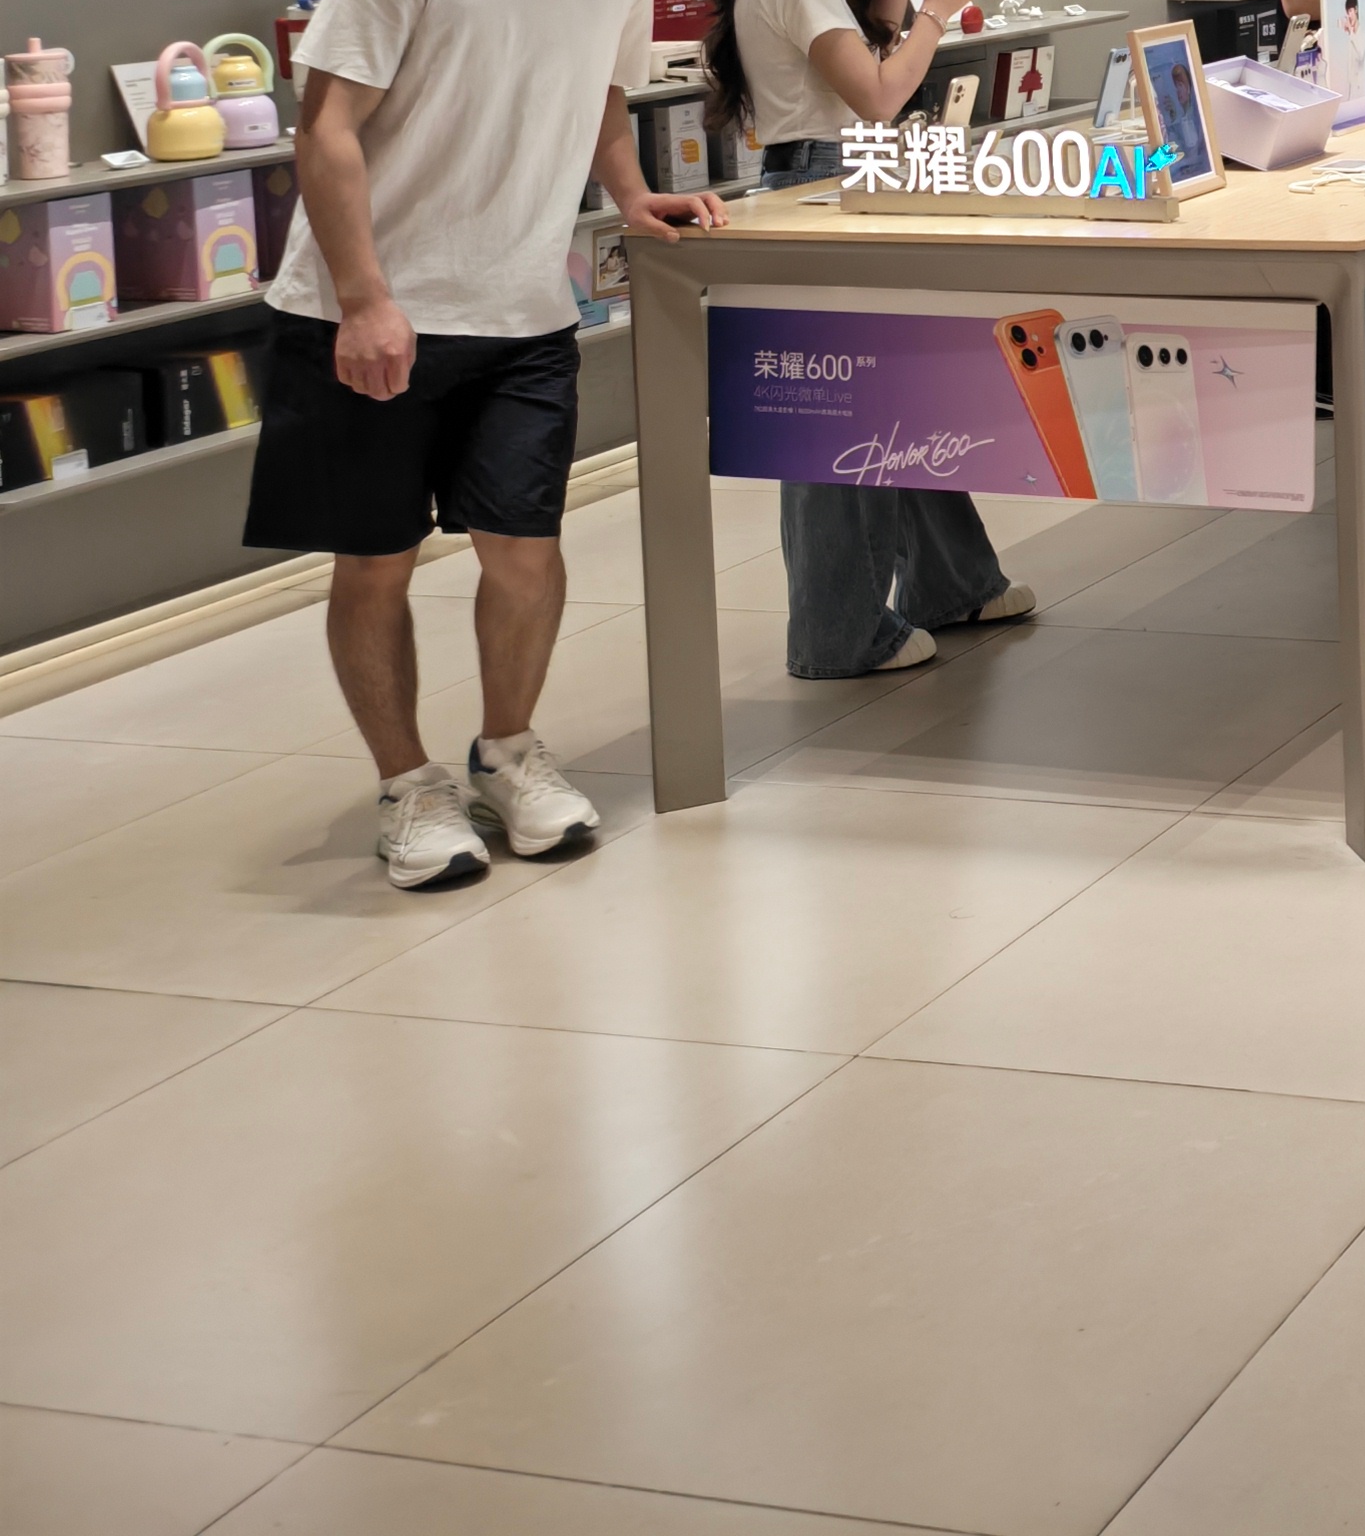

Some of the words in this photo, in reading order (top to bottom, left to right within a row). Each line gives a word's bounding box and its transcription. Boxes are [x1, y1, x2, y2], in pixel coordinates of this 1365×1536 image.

[754, 350, 852, 381] 荣耀600
[856, 356, 876, 368] 系列
[753, 384, 852, 404] 4K闪光微单Live
